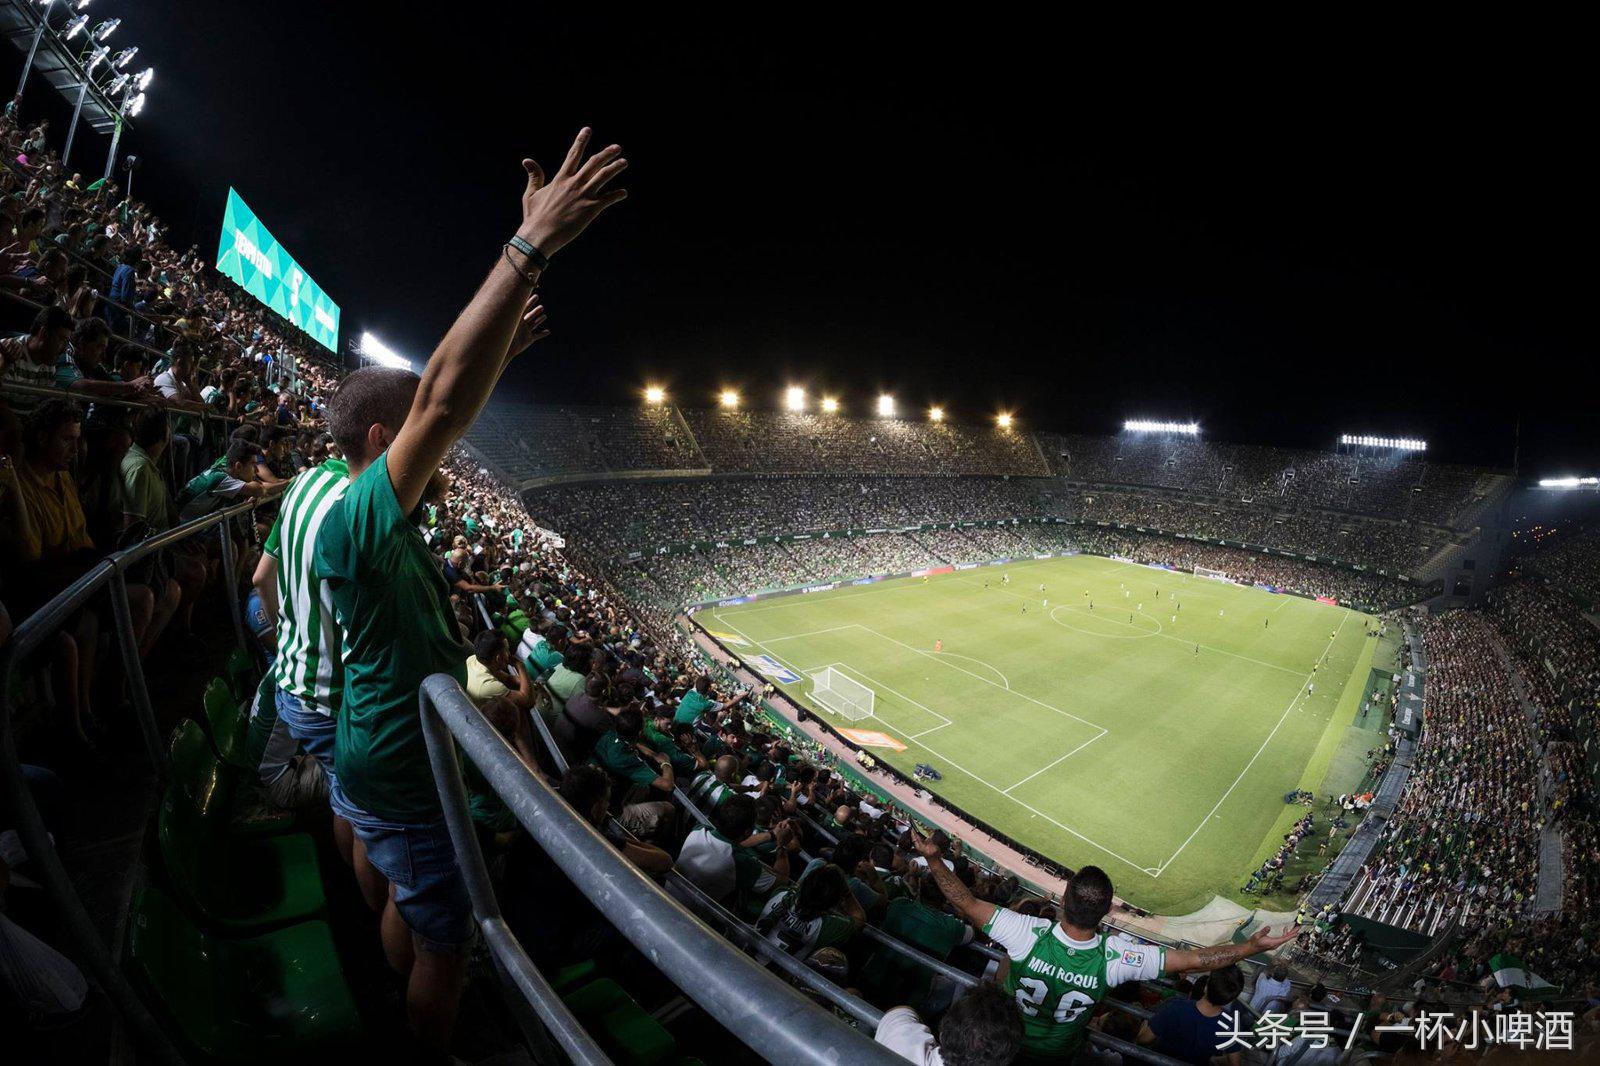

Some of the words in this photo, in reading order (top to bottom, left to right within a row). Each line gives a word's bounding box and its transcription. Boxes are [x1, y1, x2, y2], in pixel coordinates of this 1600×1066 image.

[1028, 956, 1056, 977] MIKI
[1056, 966, 1098, 989] ROQUE
[1016, 977, 1095, 1023] 26
